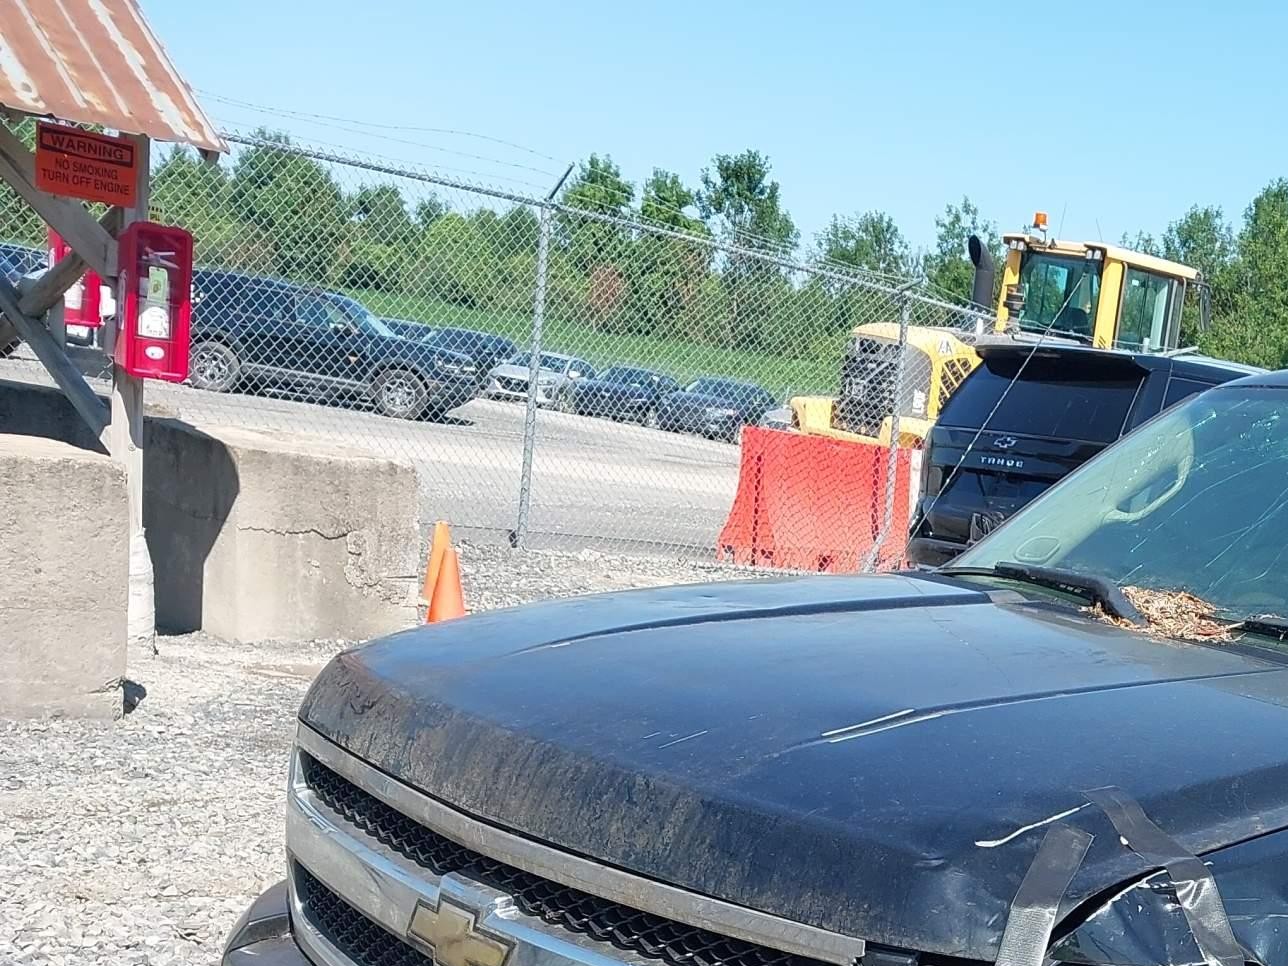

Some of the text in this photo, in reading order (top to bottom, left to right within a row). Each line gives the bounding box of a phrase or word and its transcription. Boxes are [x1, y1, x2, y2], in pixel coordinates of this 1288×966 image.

[51, 135, 124, 161] WARNING
[55, 157, 118, 180] NO SMOKING
[41, 169, 130, 196] TURN OFF ENGINE
[980, 455, 1025, 468] TAHOE
